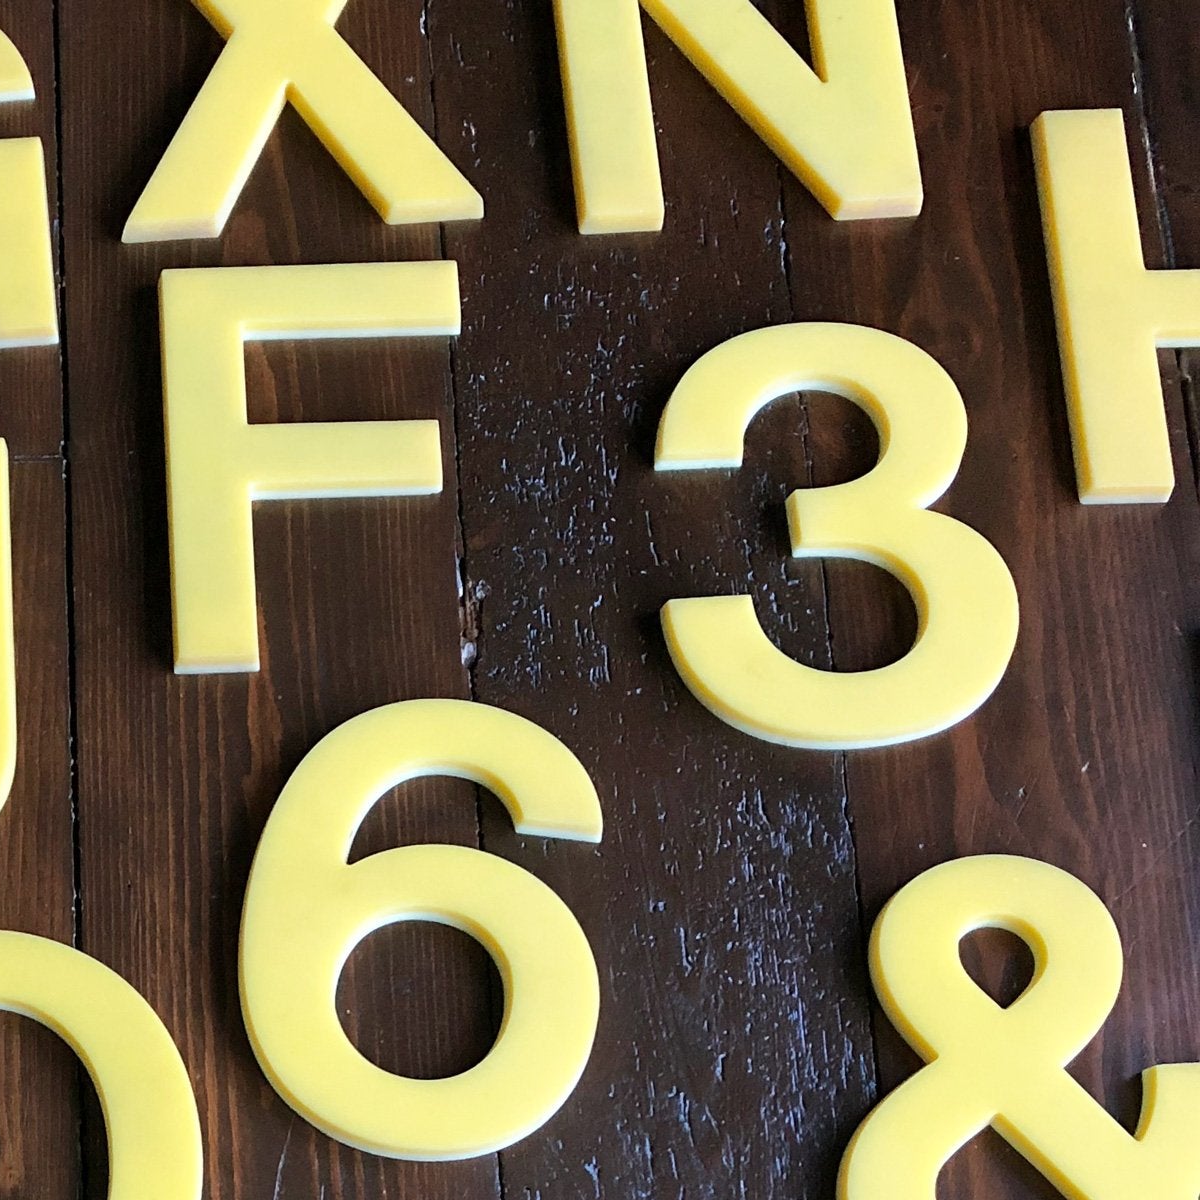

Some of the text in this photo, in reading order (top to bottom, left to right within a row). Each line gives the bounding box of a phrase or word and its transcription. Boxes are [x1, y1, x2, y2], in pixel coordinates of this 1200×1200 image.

[160, 259, 462, 675] F
[653, 321, 1020, 750] 3
[237, 698, 604, 1162] 6
